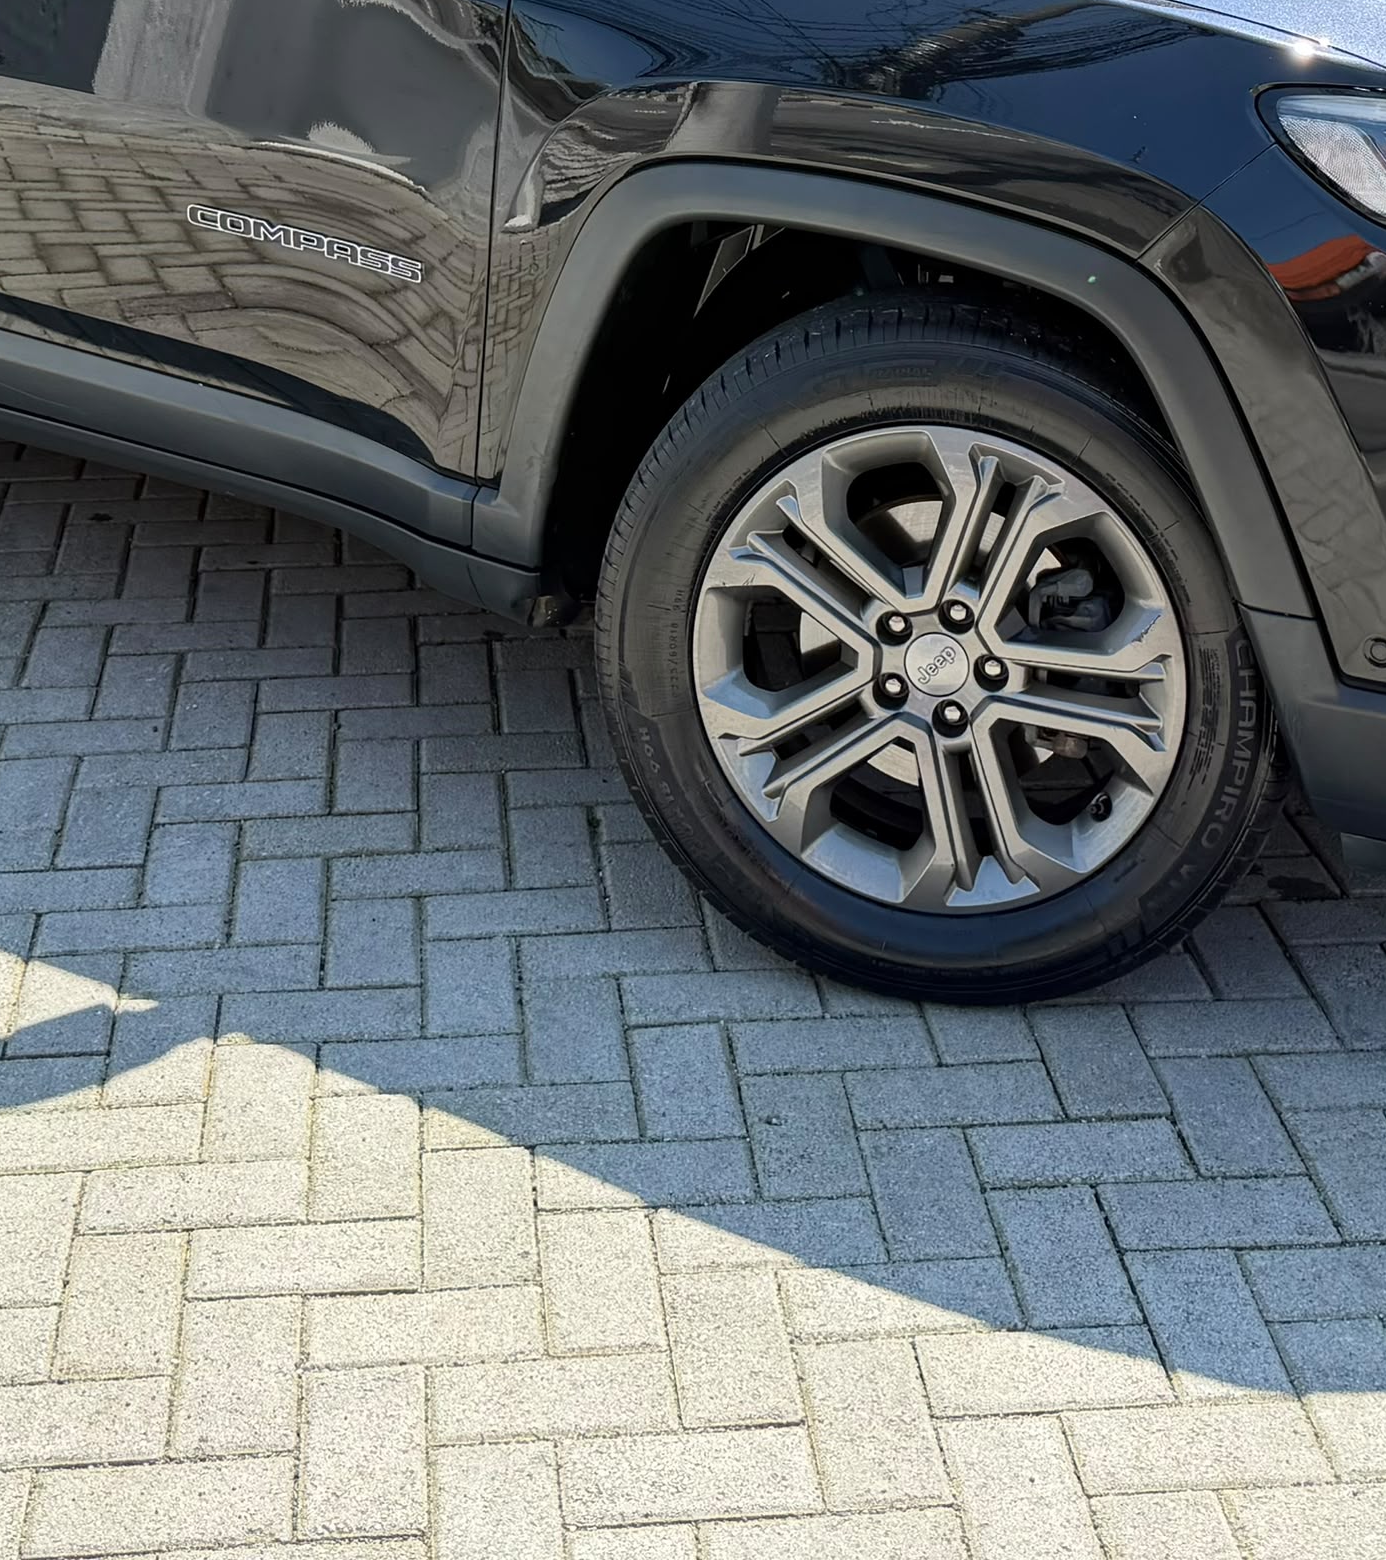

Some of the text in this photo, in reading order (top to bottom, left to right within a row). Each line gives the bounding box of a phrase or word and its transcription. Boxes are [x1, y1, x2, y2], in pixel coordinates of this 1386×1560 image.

[186, 203, 422, 284] COMPASS
[917, 646, 957, 685] Jeep
[1201, 642, 1258, 849] CHAMPIRO
